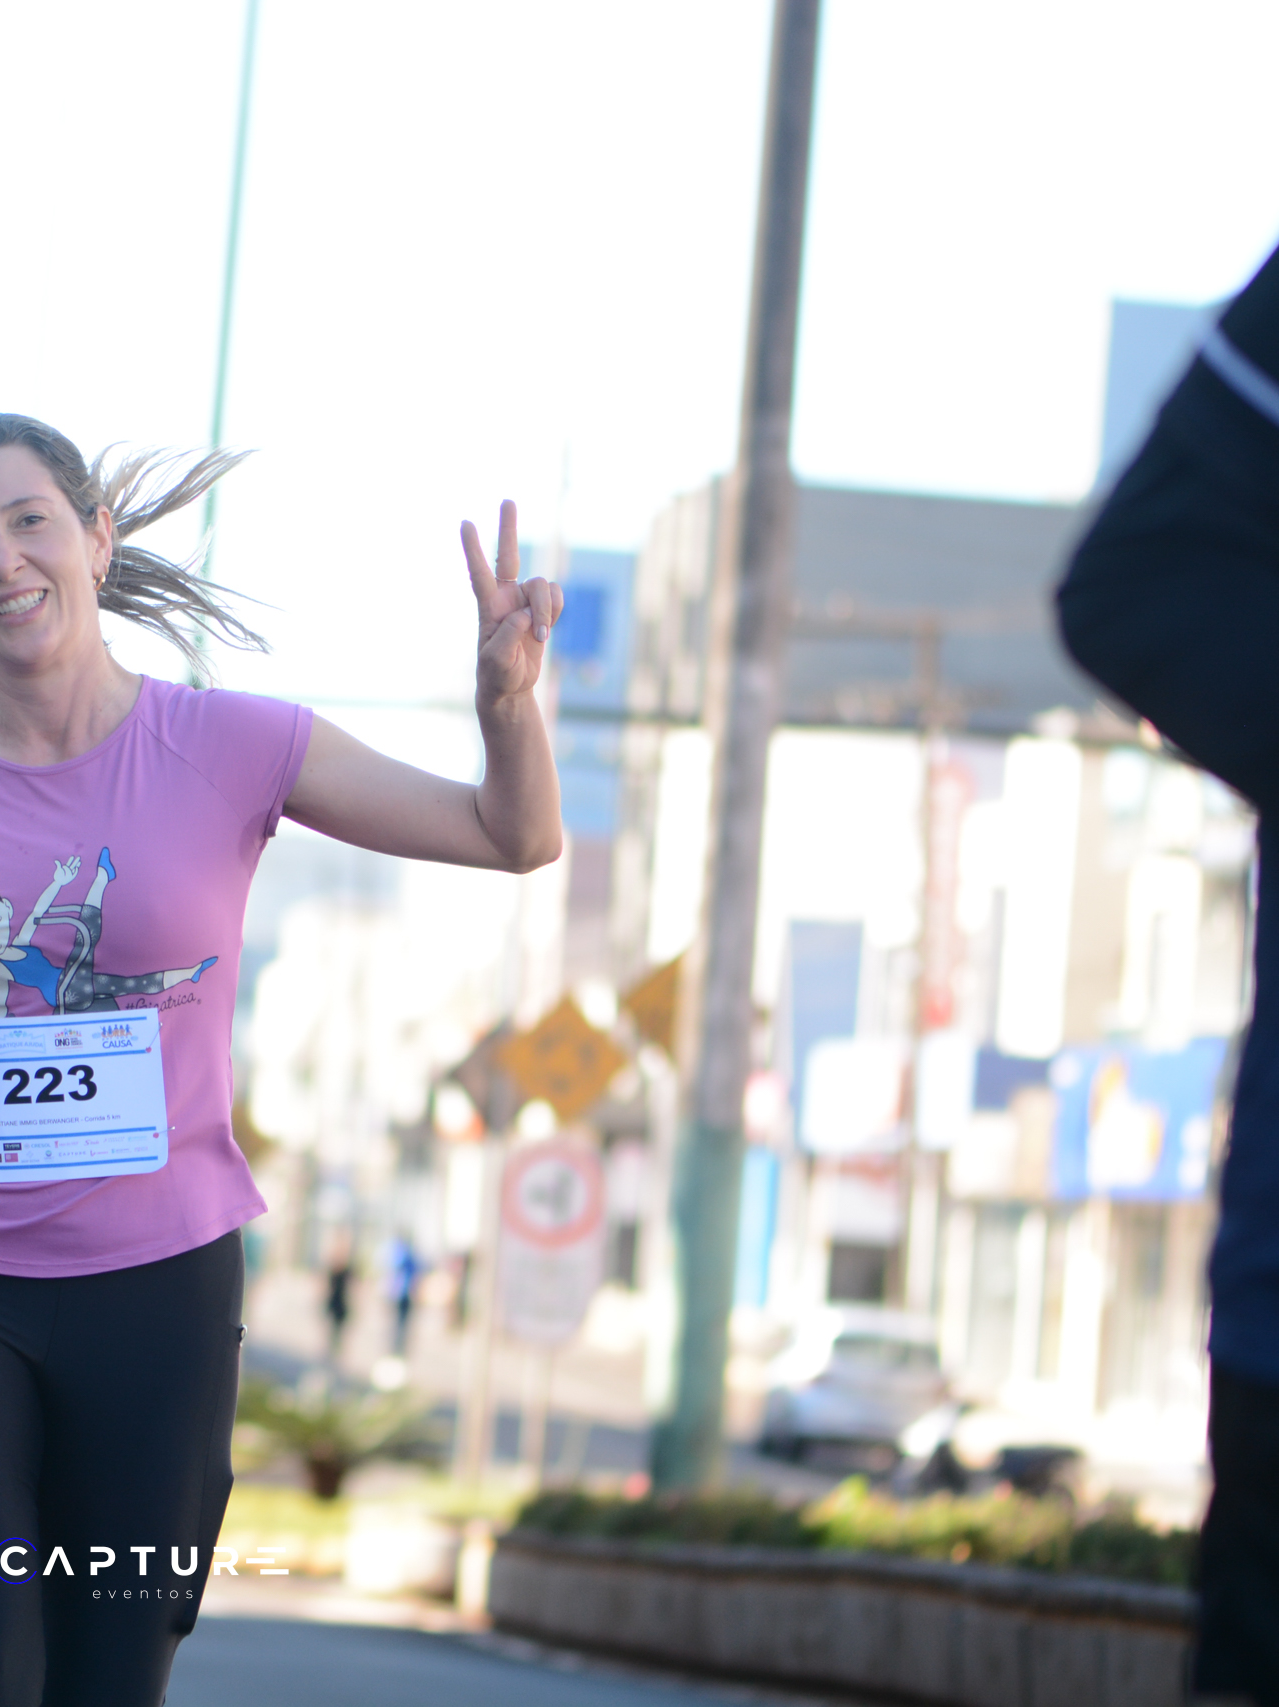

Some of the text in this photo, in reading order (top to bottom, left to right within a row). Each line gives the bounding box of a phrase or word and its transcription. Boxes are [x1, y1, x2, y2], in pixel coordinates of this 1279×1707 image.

[55, 1038, 70, 1047] ONG
[102, 1039, 133, 1049] CAUSA
[2, 1064, 97, 1105] 223
[39, 1117, 79, 1125] BERWANGER
